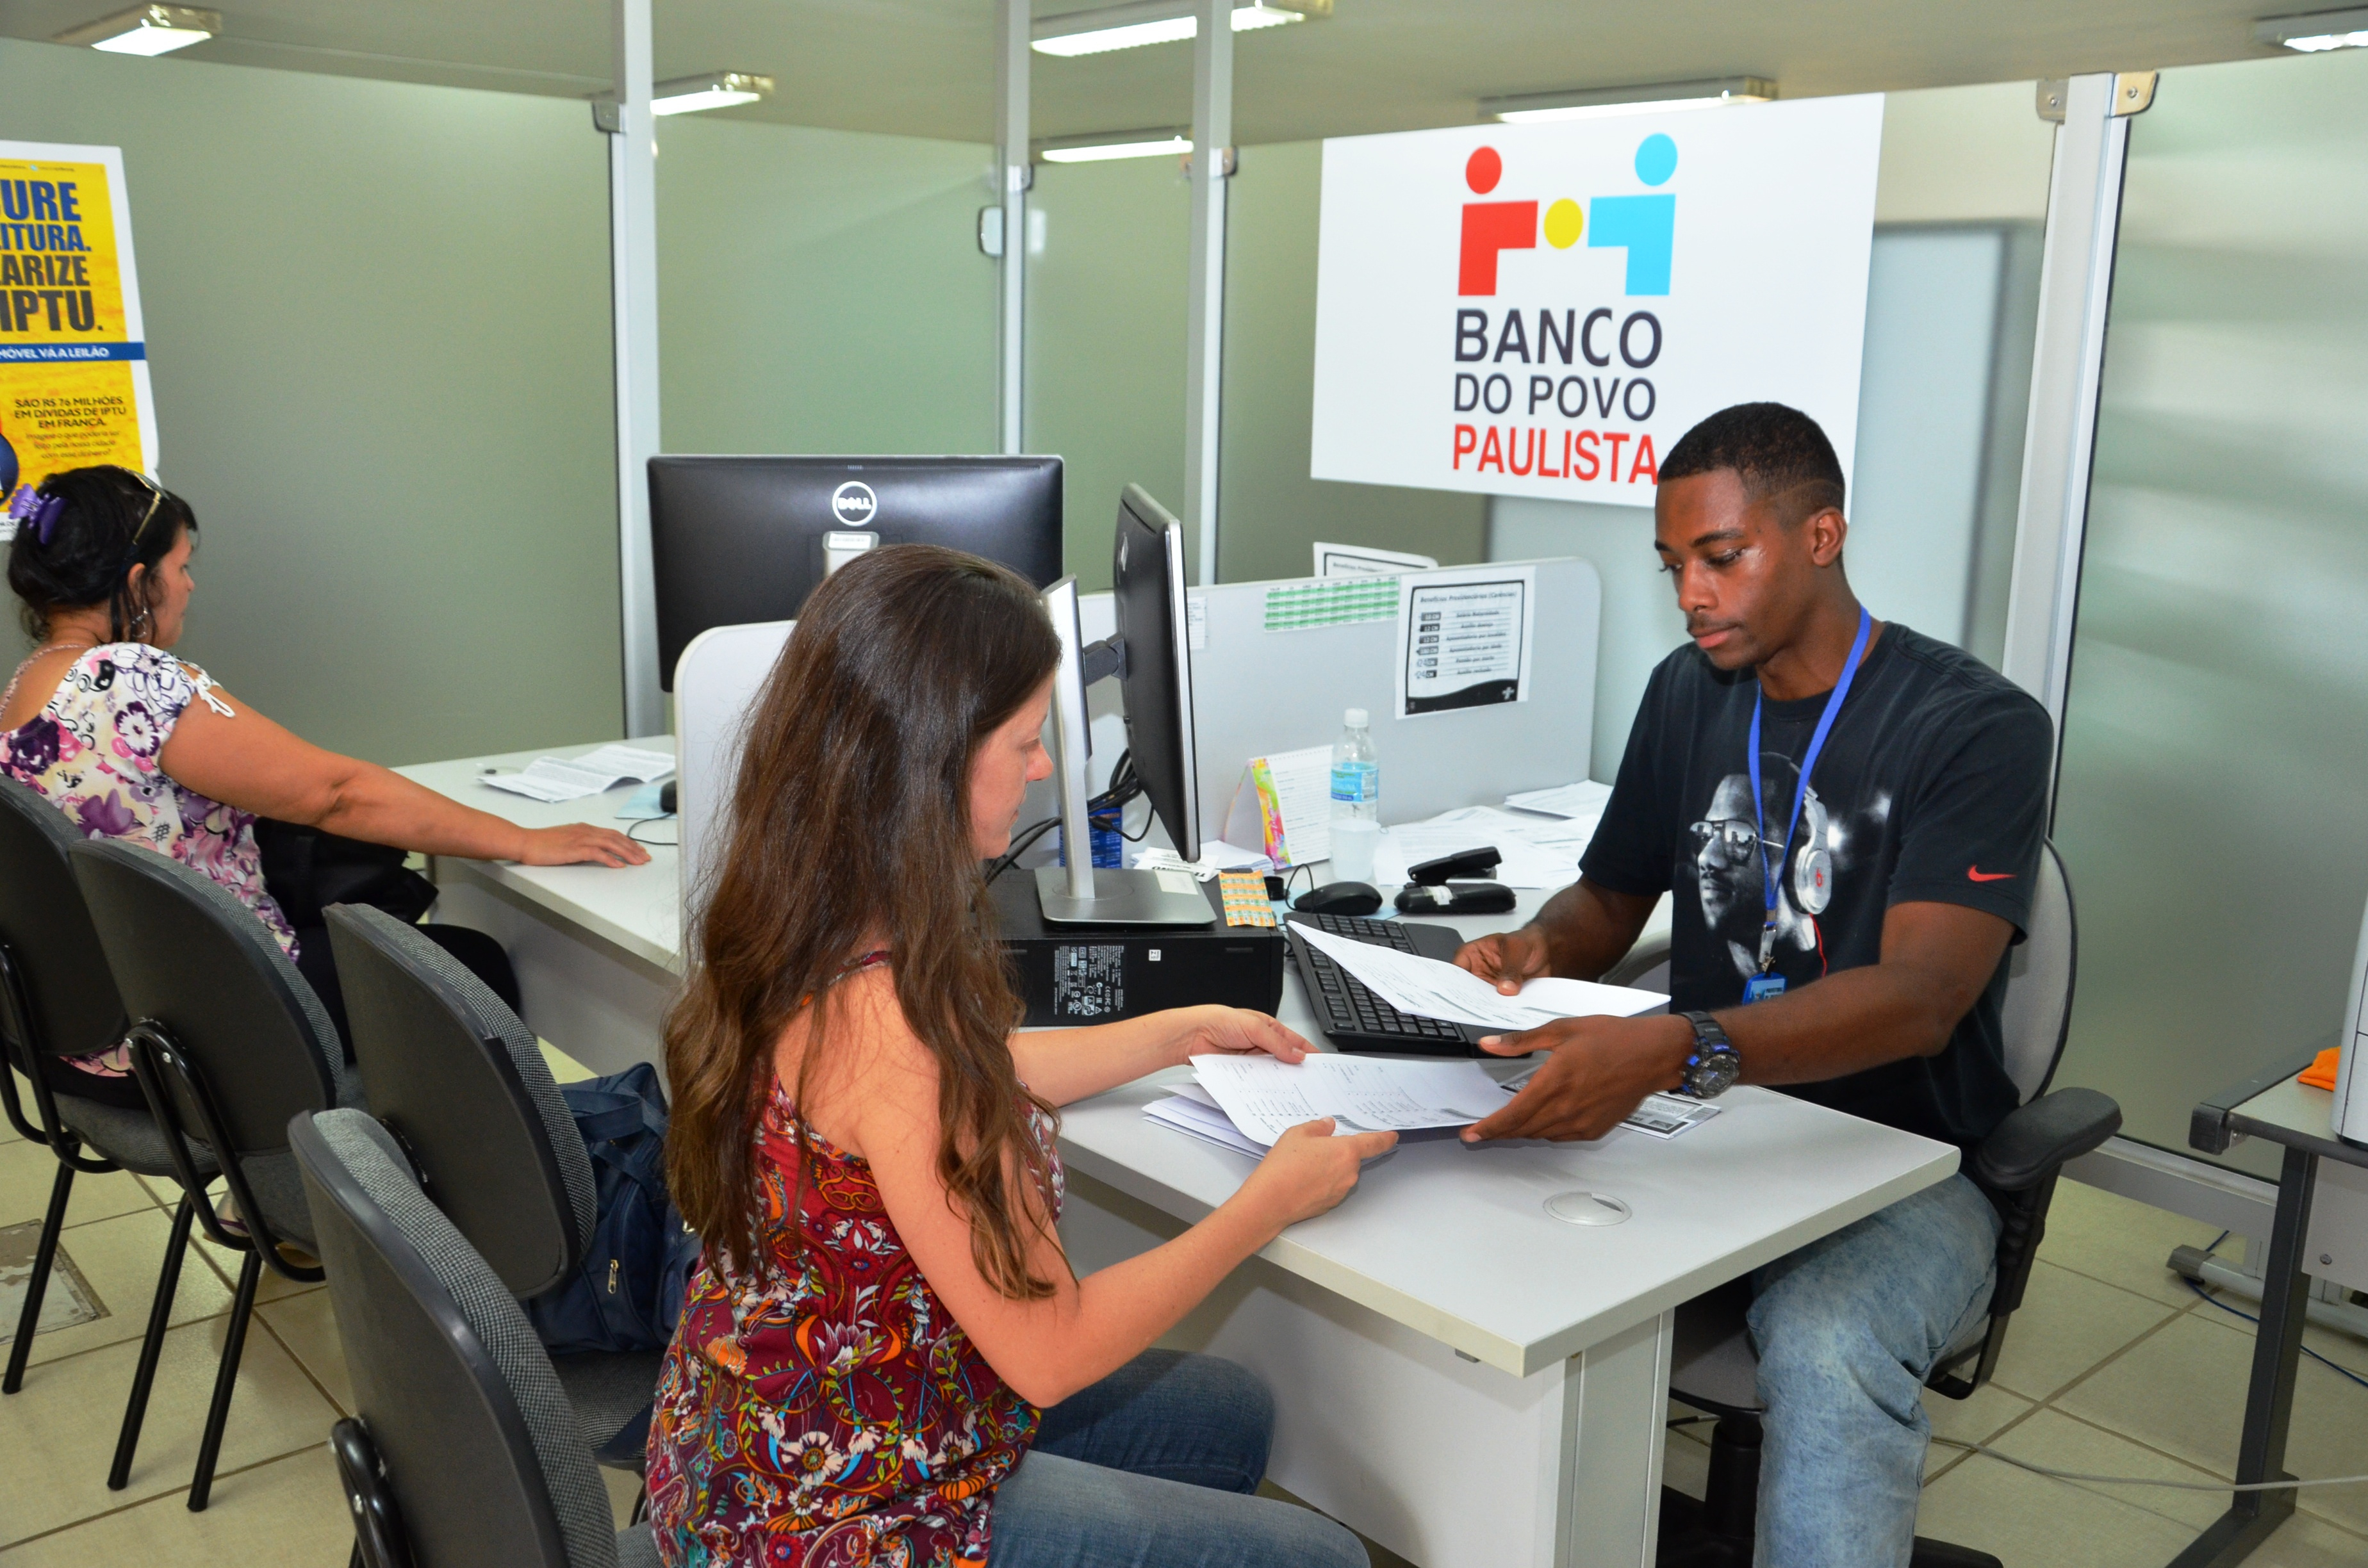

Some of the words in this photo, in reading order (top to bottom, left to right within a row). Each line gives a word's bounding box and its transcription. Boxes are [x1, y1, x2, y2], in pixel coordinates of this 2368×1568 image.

[0, 179, 81, 221] URE
[0, 223, 92, 251] ITURA.
[0, 254, 90, 286] ARIZE
[0, 290, 103, 332] IPTU.
[68, 345, 109, 358] LEILÃO
[1454, 307, 1663, 368] BANCO
[14, 410, 31, 418] EM
[83, 407, 97, 416] DE
[101, 407, 126, 416] IPTU
[1460, 372, 1512, 414] DO
[1529, 374, 1656, 421] POVO
[38, 420, 55, 429] EM
[1453, 423, 1658, 486] PAULISTA
[837, 497, 872, 510] DELL
